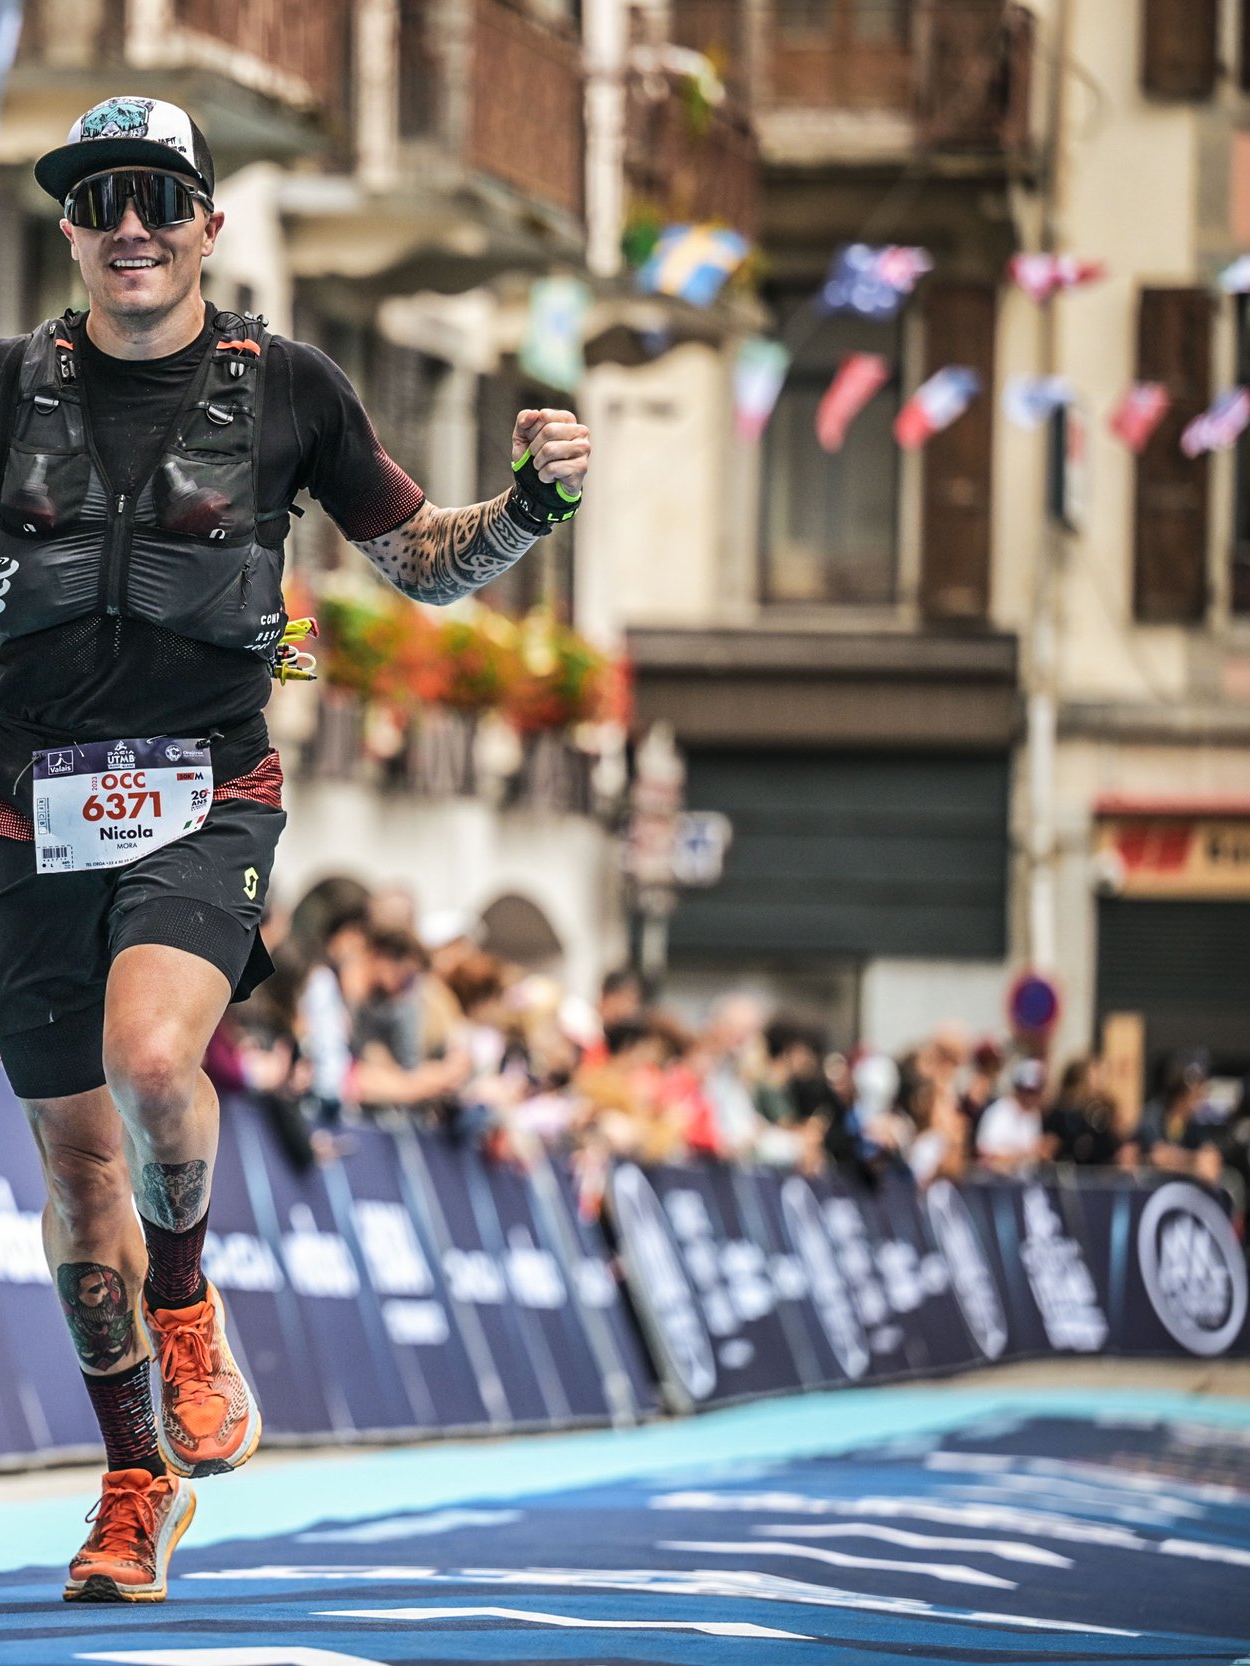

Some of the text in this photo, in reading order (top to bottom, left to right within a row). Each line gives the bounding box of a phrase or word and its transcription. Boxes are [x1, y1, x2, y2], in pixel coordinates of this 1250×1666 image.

[107, 754, 135, 764] UTMB
[50, 764, 71, 774] Valais
[101, 771, 146, 790] OCC
[194, 772, 204, 780] M
[191, 789, 208, 800] 20
[82, 791, 161, 821] 6371
[191, 799, 207, 807] ANS
[100, 824, 153, 840] Nicola
[116, 842, 138, 850] MORA
